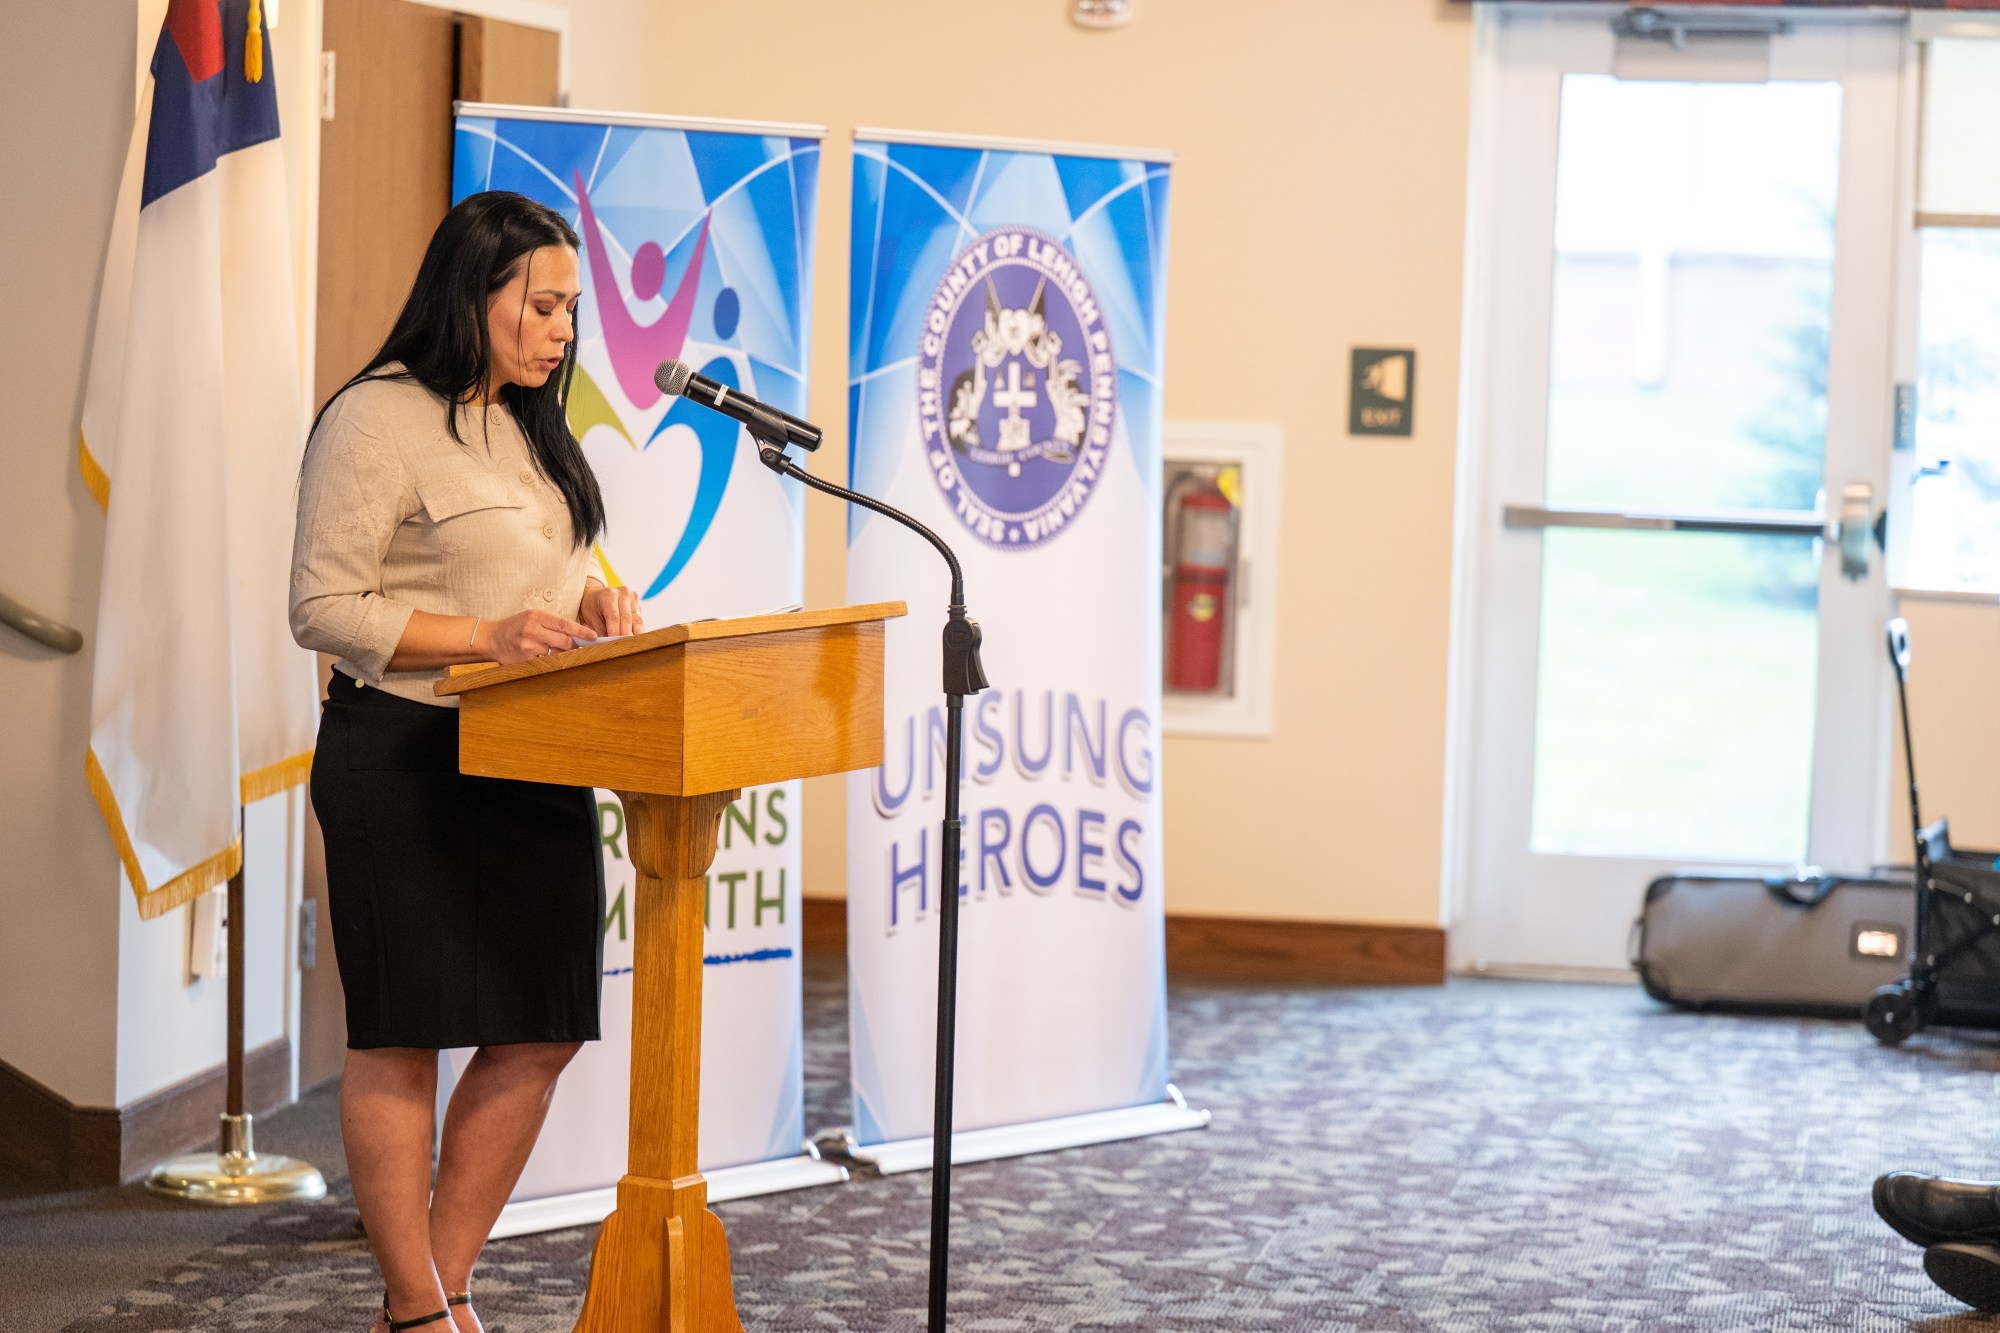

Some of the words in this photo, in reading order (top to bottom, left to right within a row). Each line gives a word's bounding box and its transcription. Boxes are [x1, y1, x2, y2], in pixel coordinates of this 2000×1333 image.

[993, 233, 1025, 259] OF
[1027, 237, 1099, 327] LEHIGH
[924, 242, 990, 357] COUNTY
[919, 367, 939, 441] THE
[1023, 330, 1114, 542] PENNSYLVANIA
[929, 450, 956, 490] OF
[956, 487, 1006, 542] SEAL
[876, 687, 1153, 812] UNSUNG
